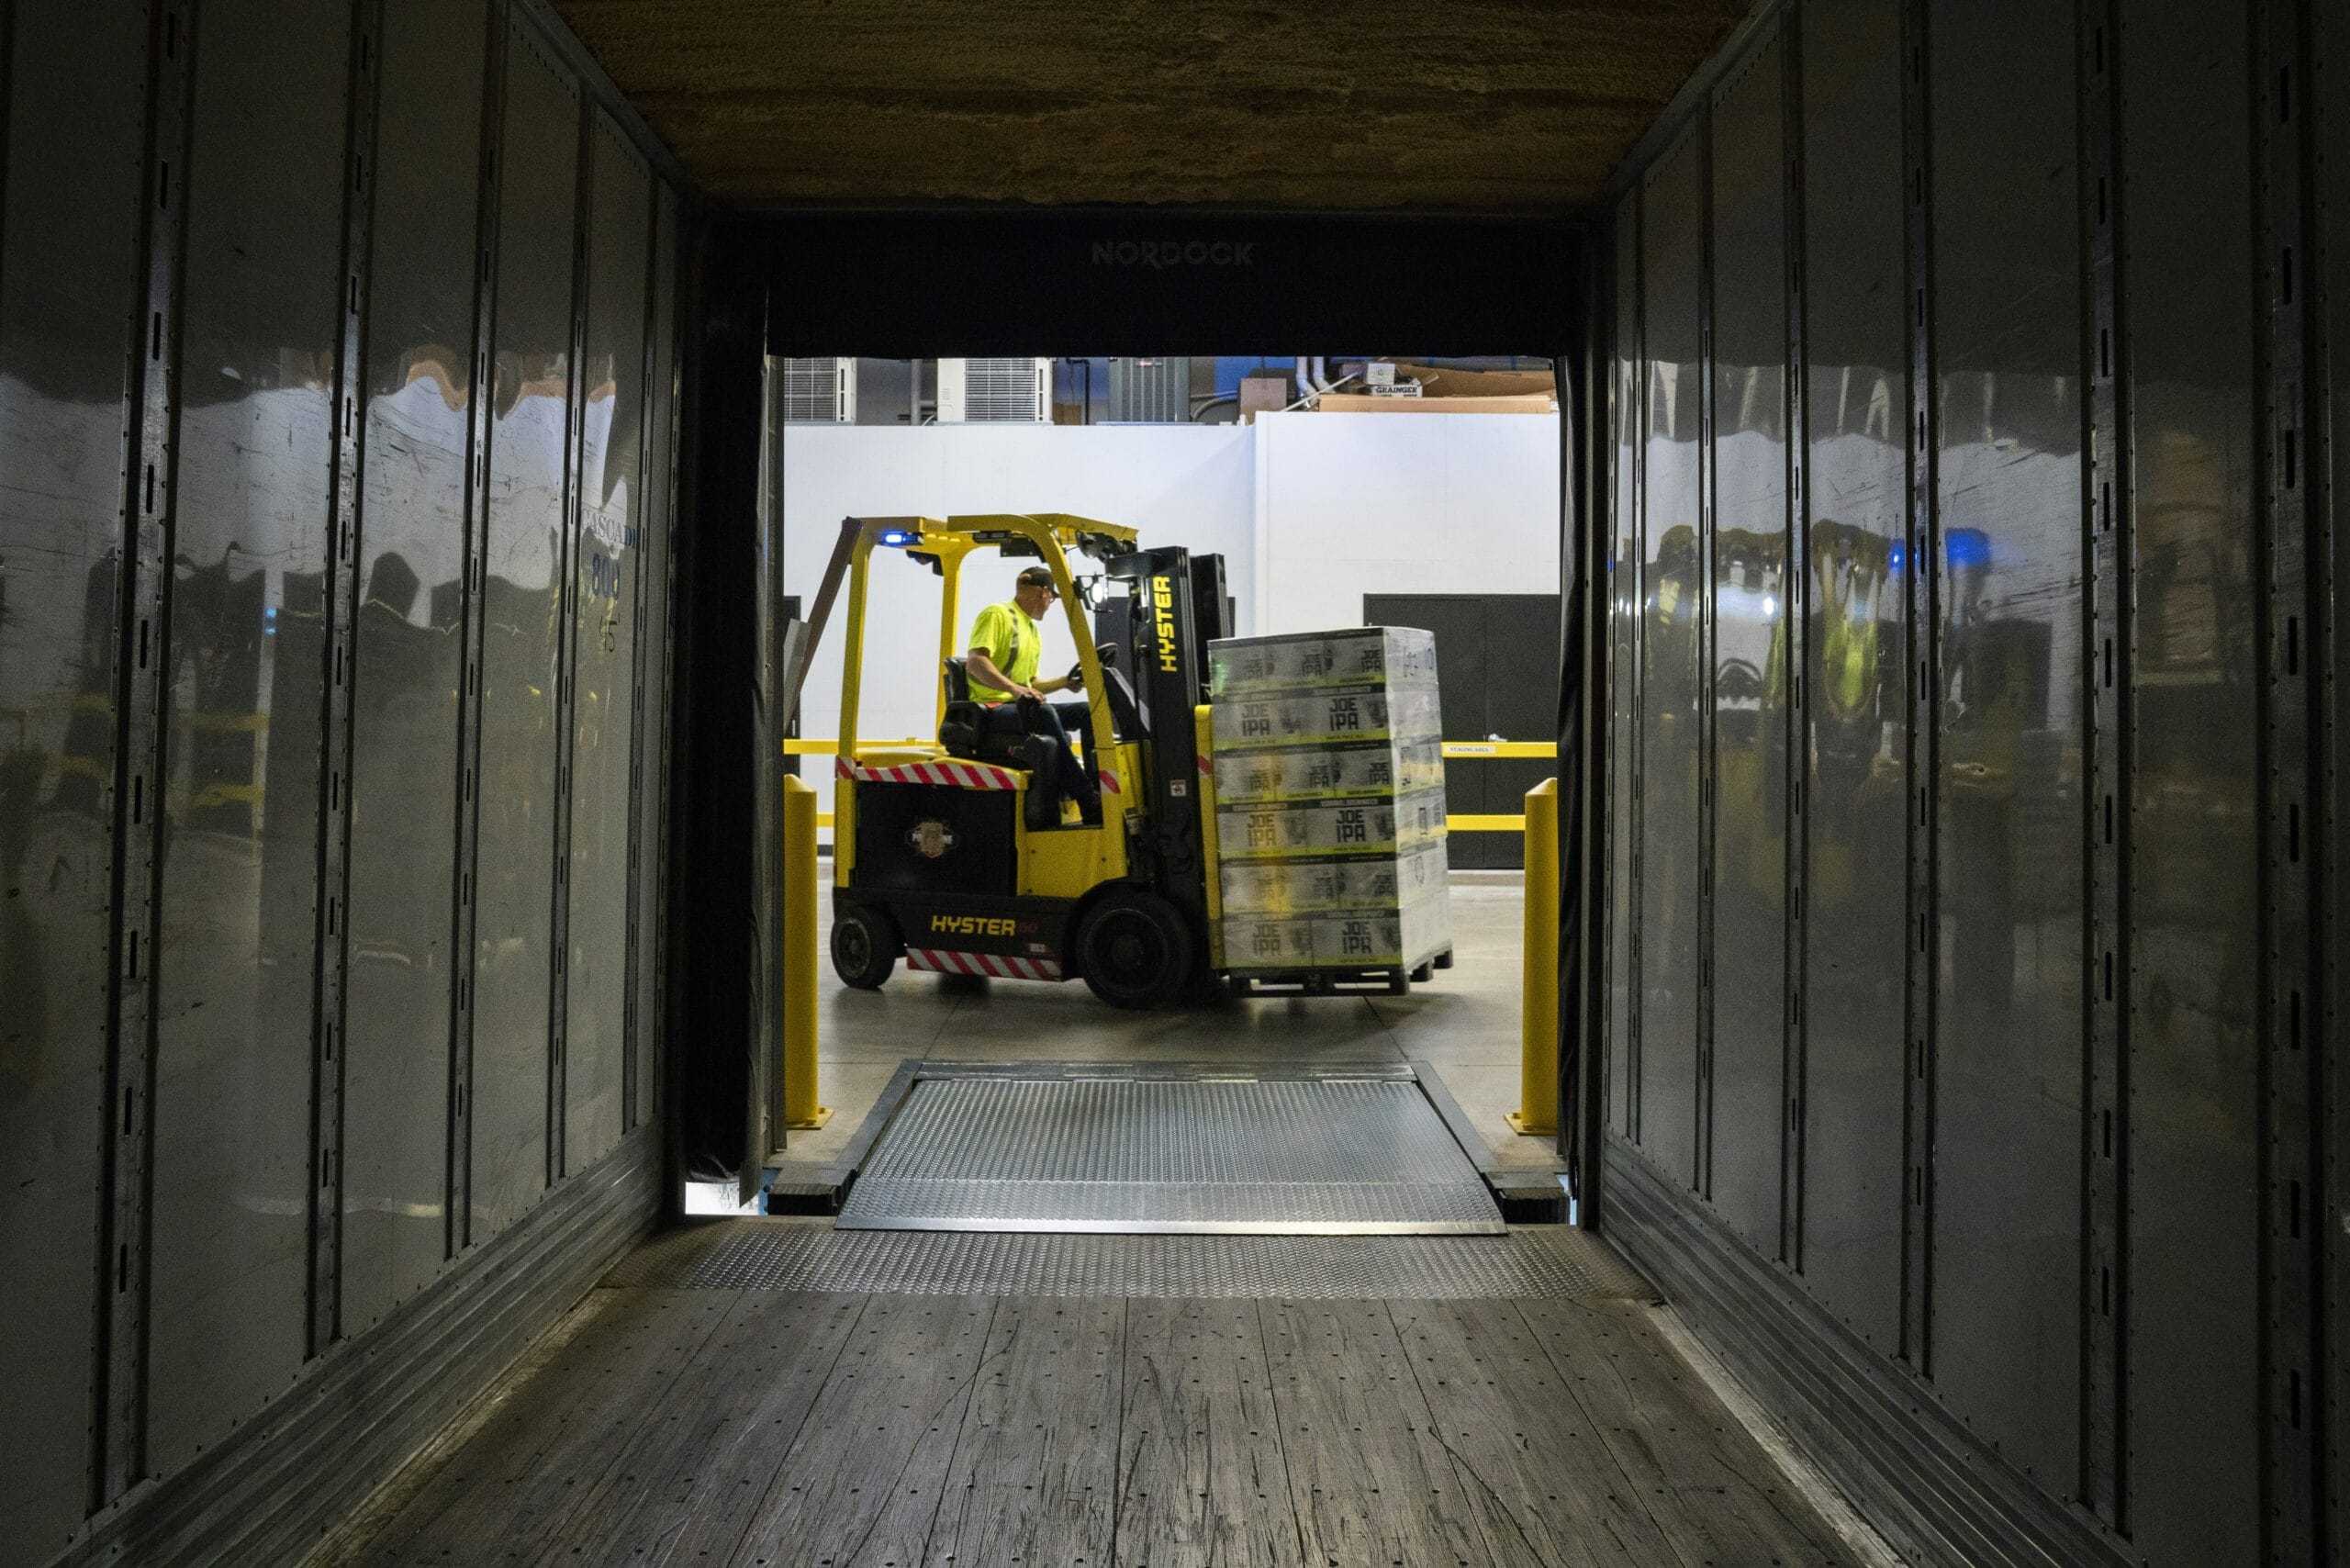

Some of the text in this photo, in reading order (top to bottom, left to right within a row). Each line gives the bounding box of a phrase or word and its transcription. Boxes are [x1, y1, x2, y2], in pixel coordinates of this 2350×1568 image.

[1091, 241, 1255, 269] NORDOCK
[592, 553, 620, 599] 800
[1153, 576, 1178, 672] HYSTER
[1241, 703, 1269, 718] JOE
[1328, 697, 1358, 712] JOE
[1242, 719, 1270, 737] IPA
[1330, 712, 1360, 732] IPA
[1369, 772, 1391, 785] IPA
[1247, 813, 1275, 828] JOE
[1336, 810, 1364, 824] JOE
[1248, 828, 1277, 847] IPA
[1336, 825, 1367, 843] IPA
[931, 915, 1016, 936] HYSTER
[1252, 922, 1281, 938] JOE
[1342, 921, 1371, 936] JOE
[1252, 938, 1282, 957] IPA
[1342, 937, 1373, 955] IPA
